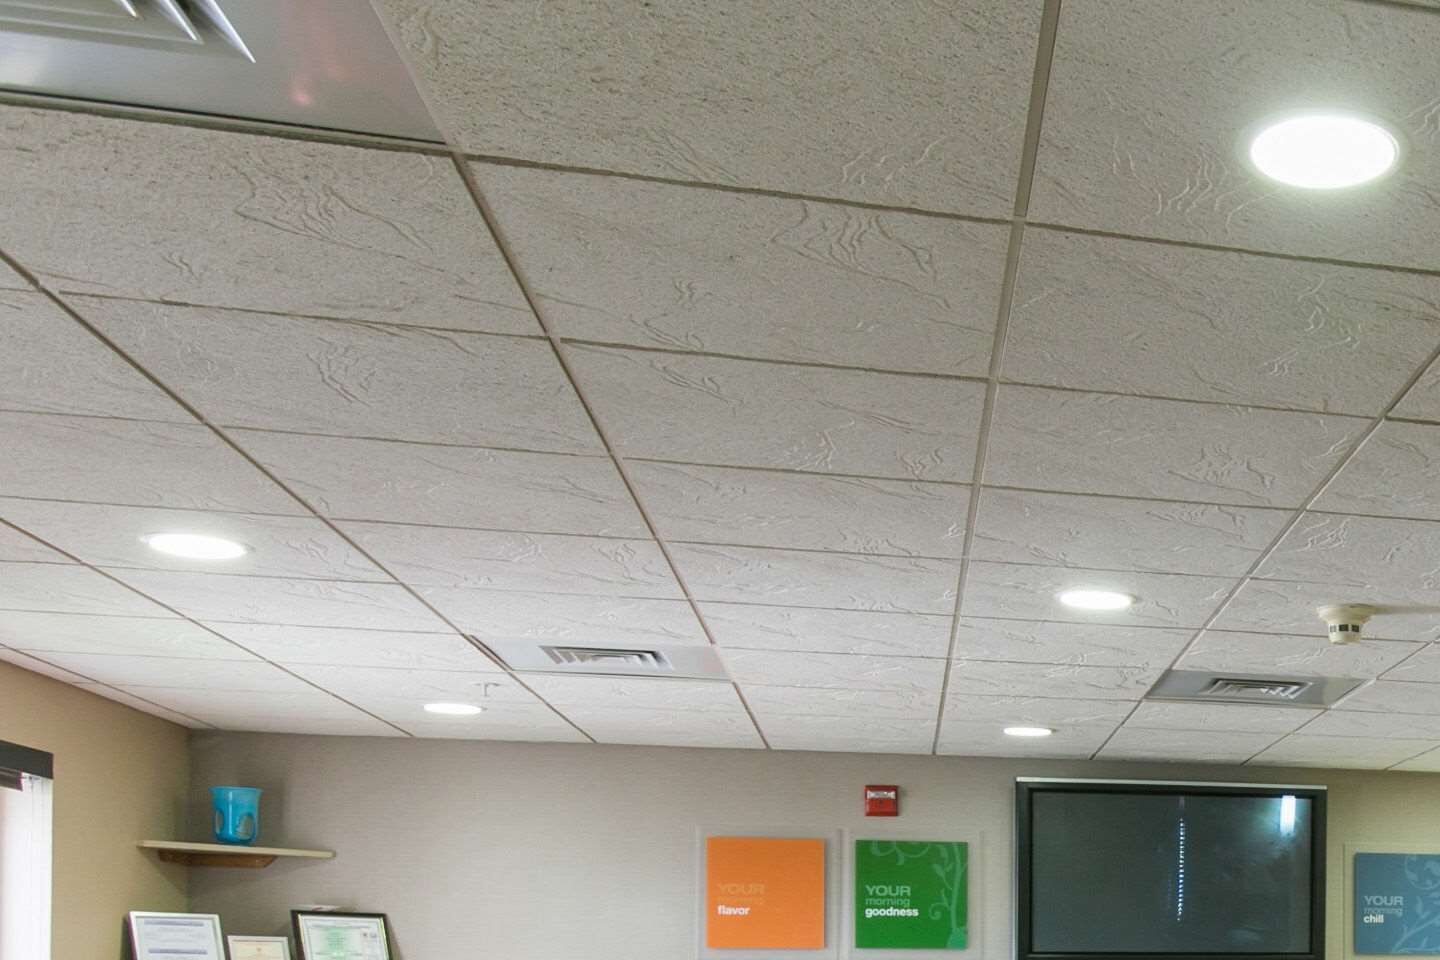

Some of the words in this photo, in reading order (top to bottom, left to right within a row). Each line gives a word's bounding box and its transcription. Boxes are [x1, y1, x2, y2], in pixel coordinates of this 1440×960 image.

[865, 885, 912, 897] YOUR
[865, 898, 911, 908] morning
[1363, 895, 1404, 906] YOUR
[717, 904, 751, 916] flavor
[865, 906, 919, 919] goodness
[1363, 914, 1385, 924] chill
